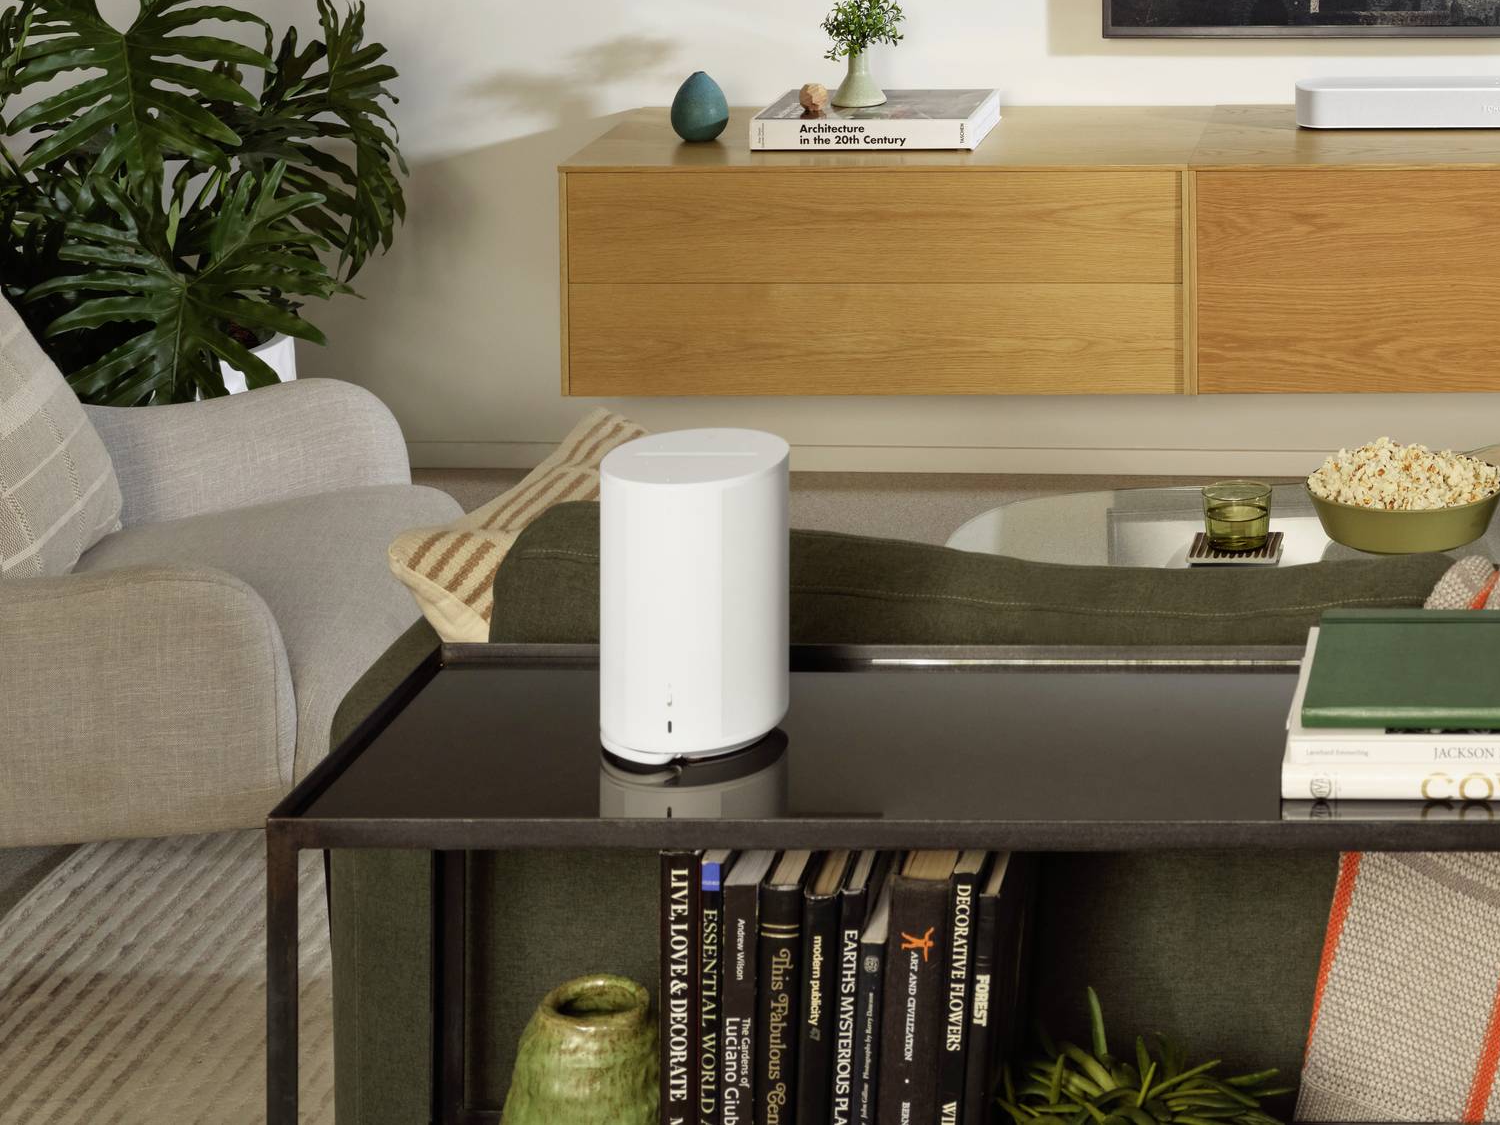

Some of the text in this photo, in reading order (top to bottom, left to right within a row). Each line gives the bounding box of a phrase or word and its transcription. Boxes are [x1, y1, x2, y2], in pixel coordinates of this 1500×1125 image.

[800, 123, 865, 134] Architecture
[800, 135, 906, 147] in the 20th Century
[1434, 747, 1495, 760] JACKSON
[668, 868, 688, 921] LIVE,
[670, 923, 688, 977] LOVE
[736, 918, 746, 981] Andrew Wilson
[811, 935, 824, 979] modern
[951, 884, 972, 979] DECORATIVE
[670, 979, 688, 995] &
[702, 909, 718, 1027] ESSENTIAL
[771, 948, 794, 991] This
[841, 930, 858, 993] EARTH'S
[908, 972, 918, 996] AND
[909, 951, 919, 972] ART
[807, 980, 822, 1026] publicity
[904, 997, 916, 1062] CIVILIZATION
[946, 983, 965, 1052] FLOWERS
[973, 974, 991, 1027] FOREST
[669, 998, 688, 1102] DECORATE
[724, 1017, 741, 1083] Luciano
[738, 1017, 751, 1089] The Gardens of
[768, 993, 789, 1080] Fabulous
[835, 996, 855, 1095] MYSTERIOUS
[701, 1033, 716, 1114] WORLD
